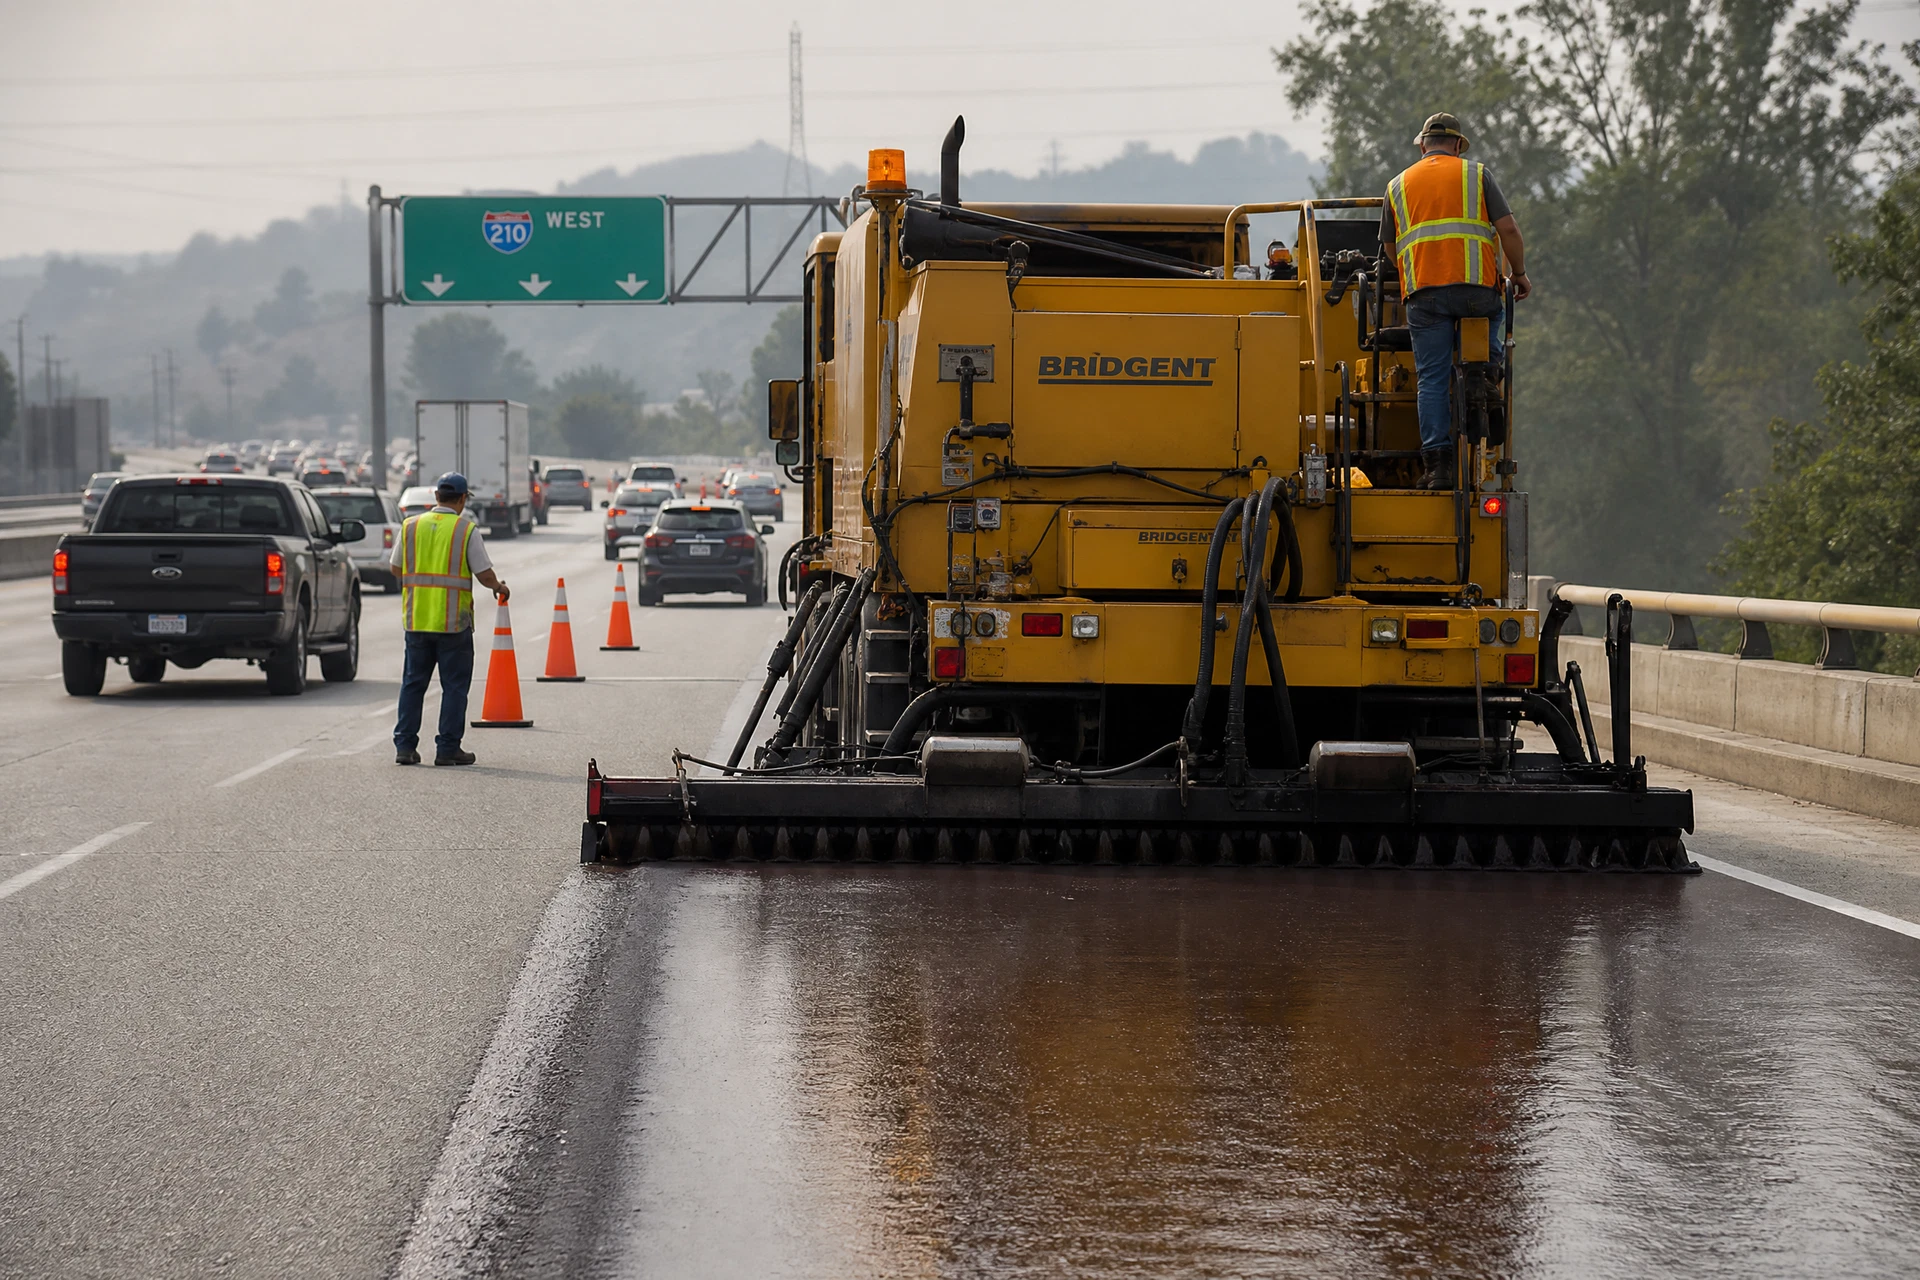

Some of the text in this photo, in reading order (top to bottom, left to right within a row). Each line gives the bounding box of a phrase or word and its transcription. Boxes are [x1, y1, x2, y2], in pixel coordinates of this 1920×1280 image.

[545, 211, 605, 228] WEST
[490, 223, 527, 243] 210
[1038, 356, 1217, 378] BRIDGENT
